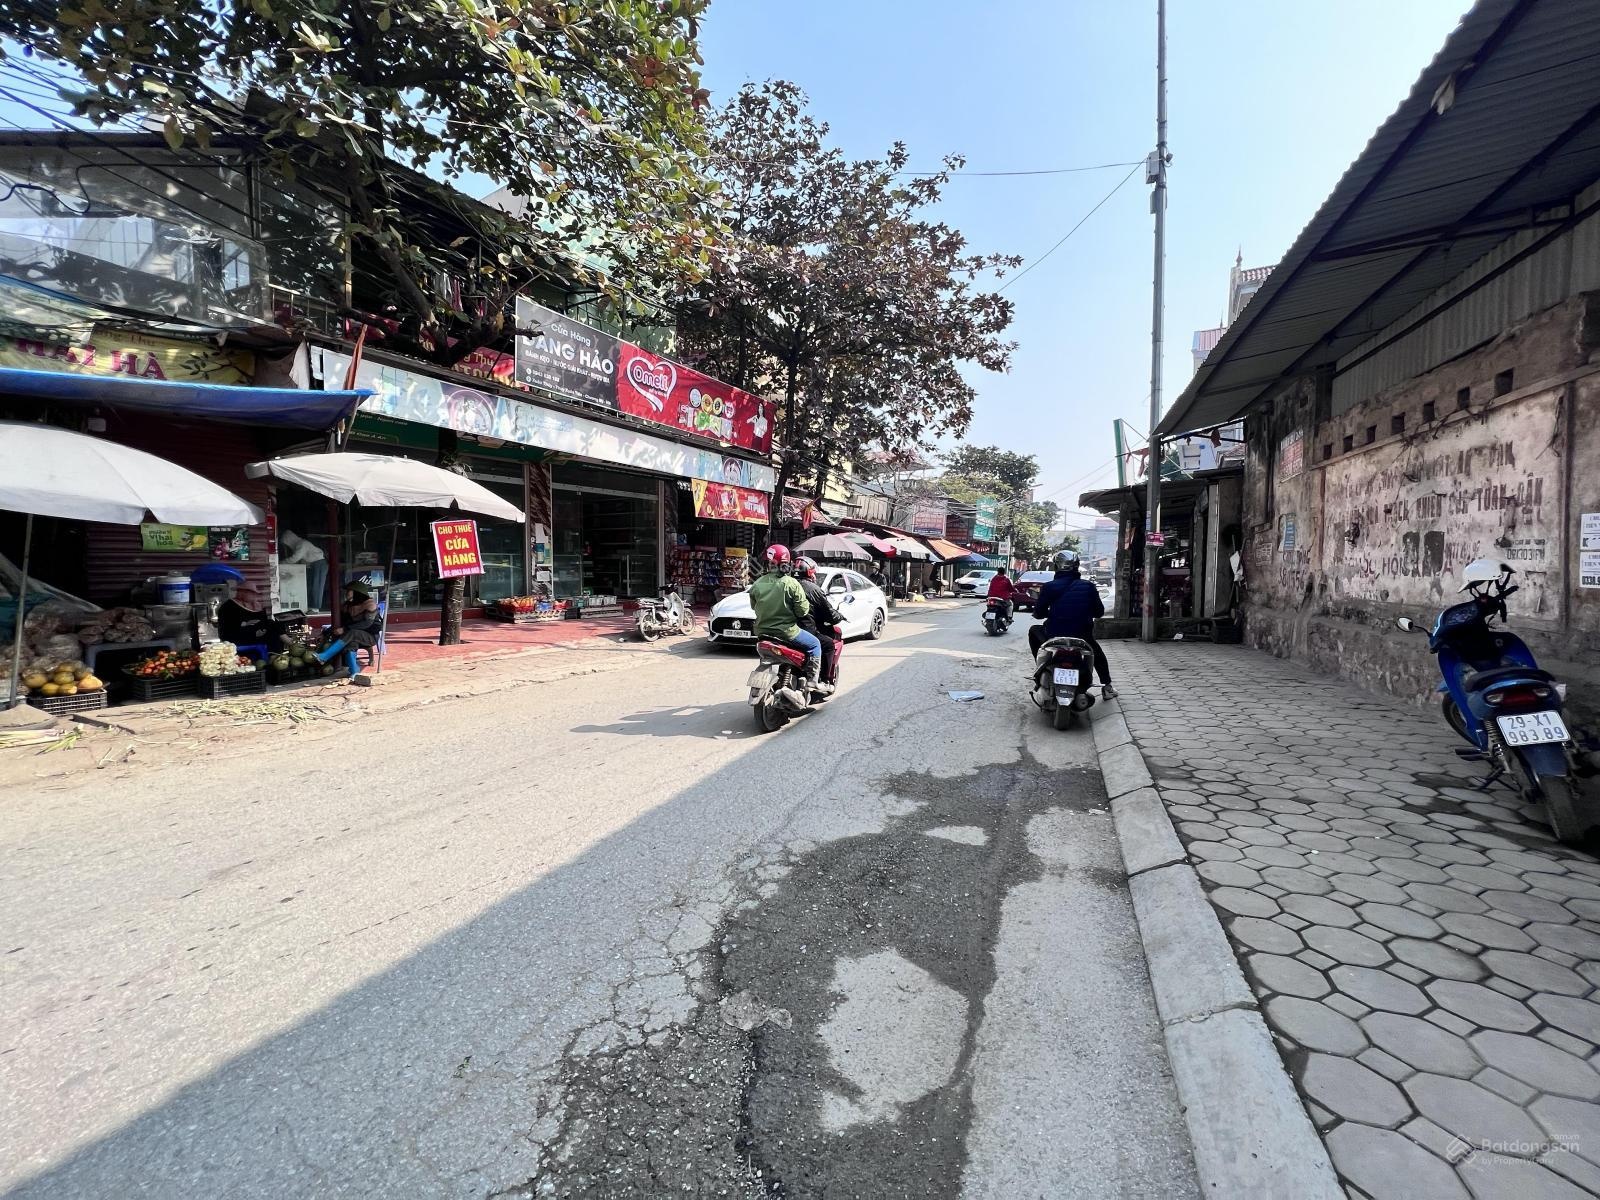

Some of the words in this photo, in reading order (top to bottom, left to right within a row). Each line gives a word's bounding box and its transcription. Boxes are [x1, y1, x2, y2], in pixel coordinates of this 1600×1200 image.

[551, 322, 568, 337] Cửa
[570, 329, 591, 347] Hàng
[580, 349, 614, 375] HẢO
[633, 365, 669, 392] Omeli
[437, 525, 453, 535] CHO
[453, 522, 473, 534] THUÊ
[445, 535, 470, 551] CỬA
[443, 552, 477, 566] HÀNG
[1507, 713, 1552, 730] 29-X1
[1508, 727, 1565, 743] 983.89
